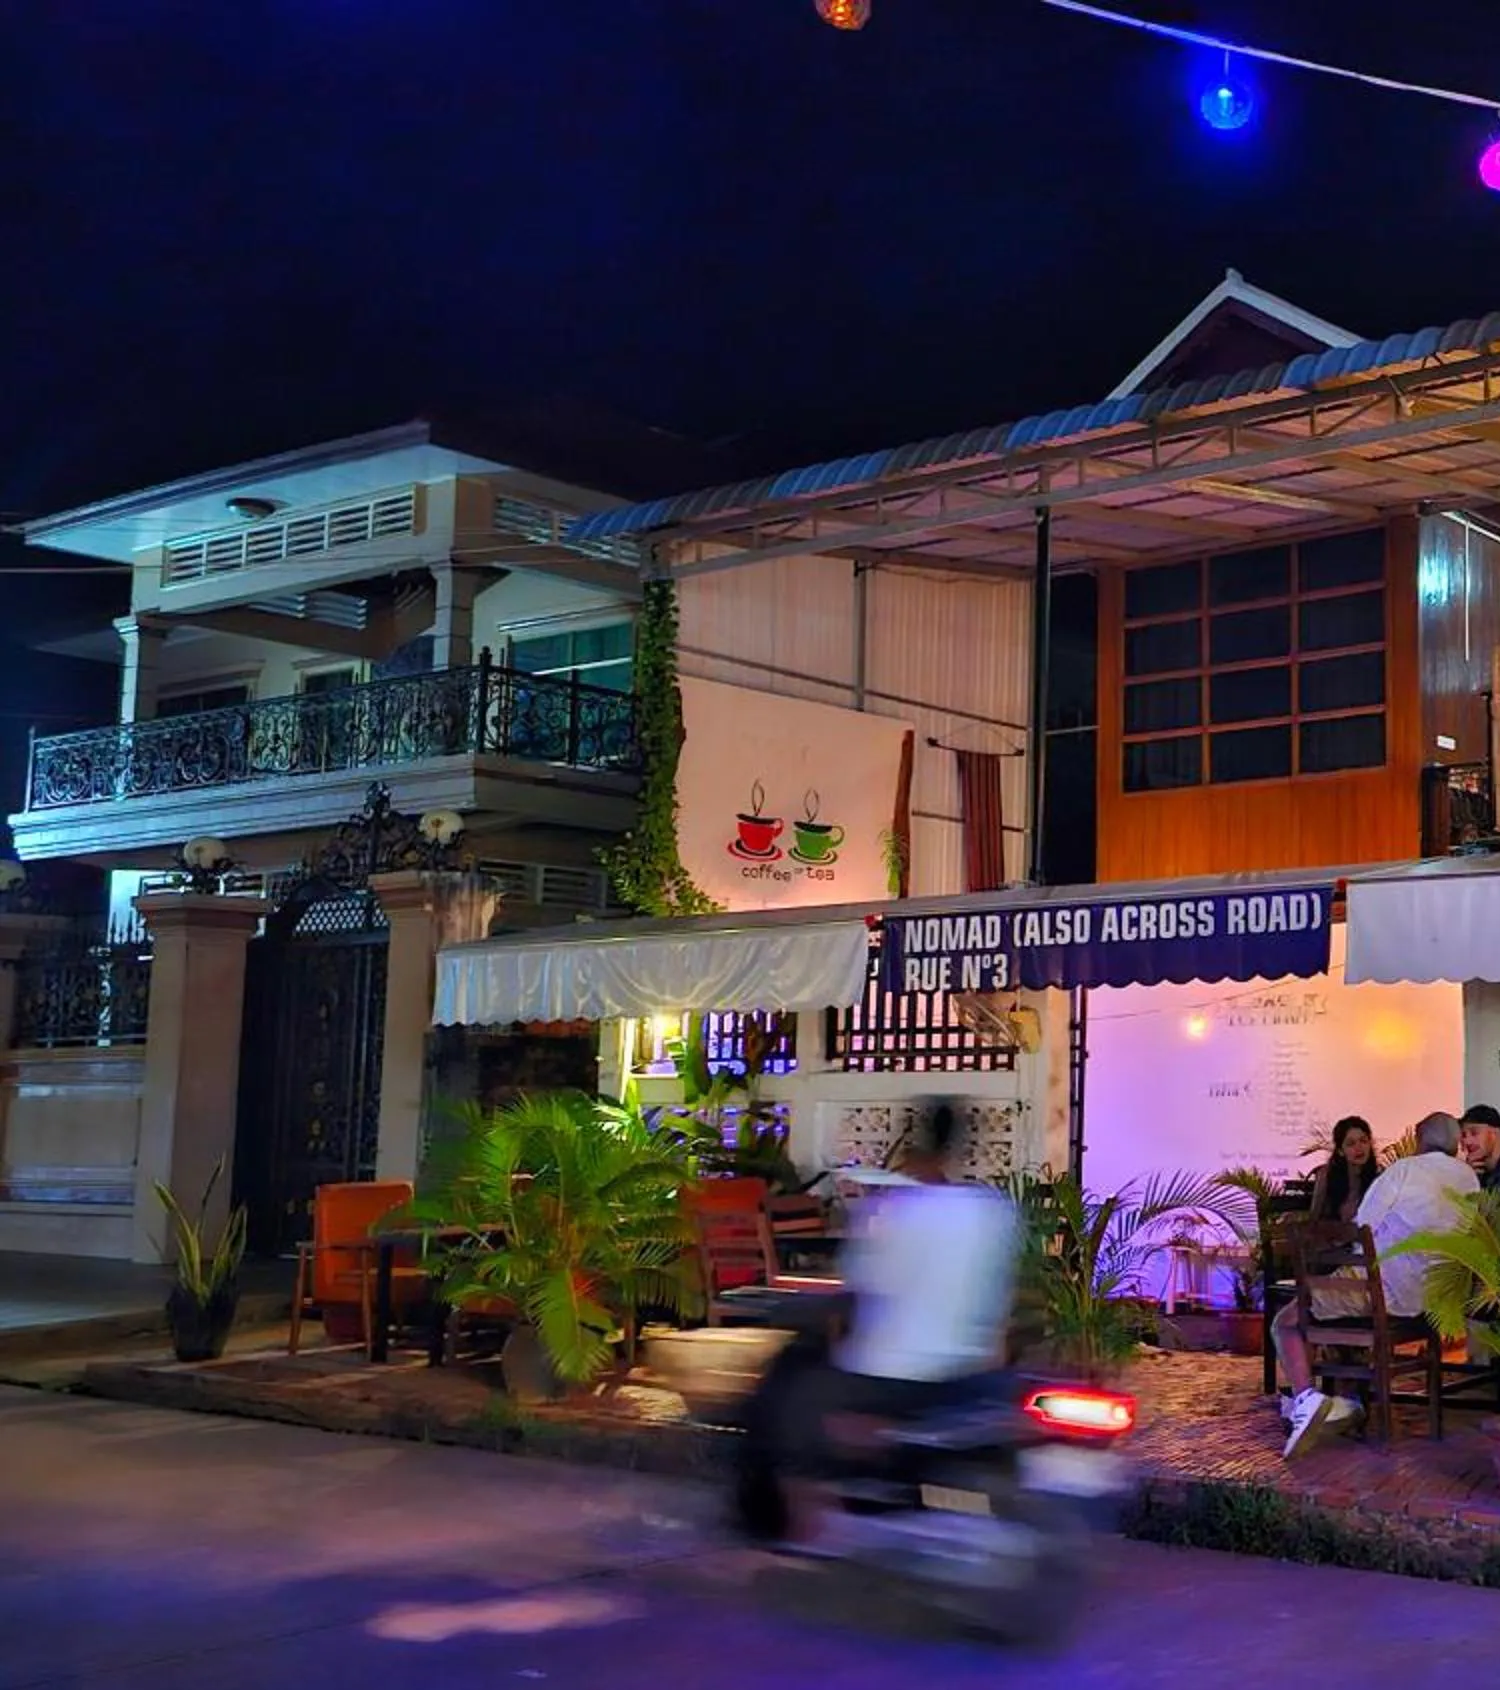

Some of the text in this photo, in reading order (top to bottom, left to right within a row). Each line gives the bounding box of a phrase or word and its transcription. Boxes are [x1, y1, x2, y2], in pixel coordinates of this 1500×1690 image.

[741, 863, 792, 882] coffee
[806, 866, 835, 881] tea
[904, 892, 1323, 953] NOMAD (ALSO ACROSS ROAD)
[905, 957, 951, 991] RUE
